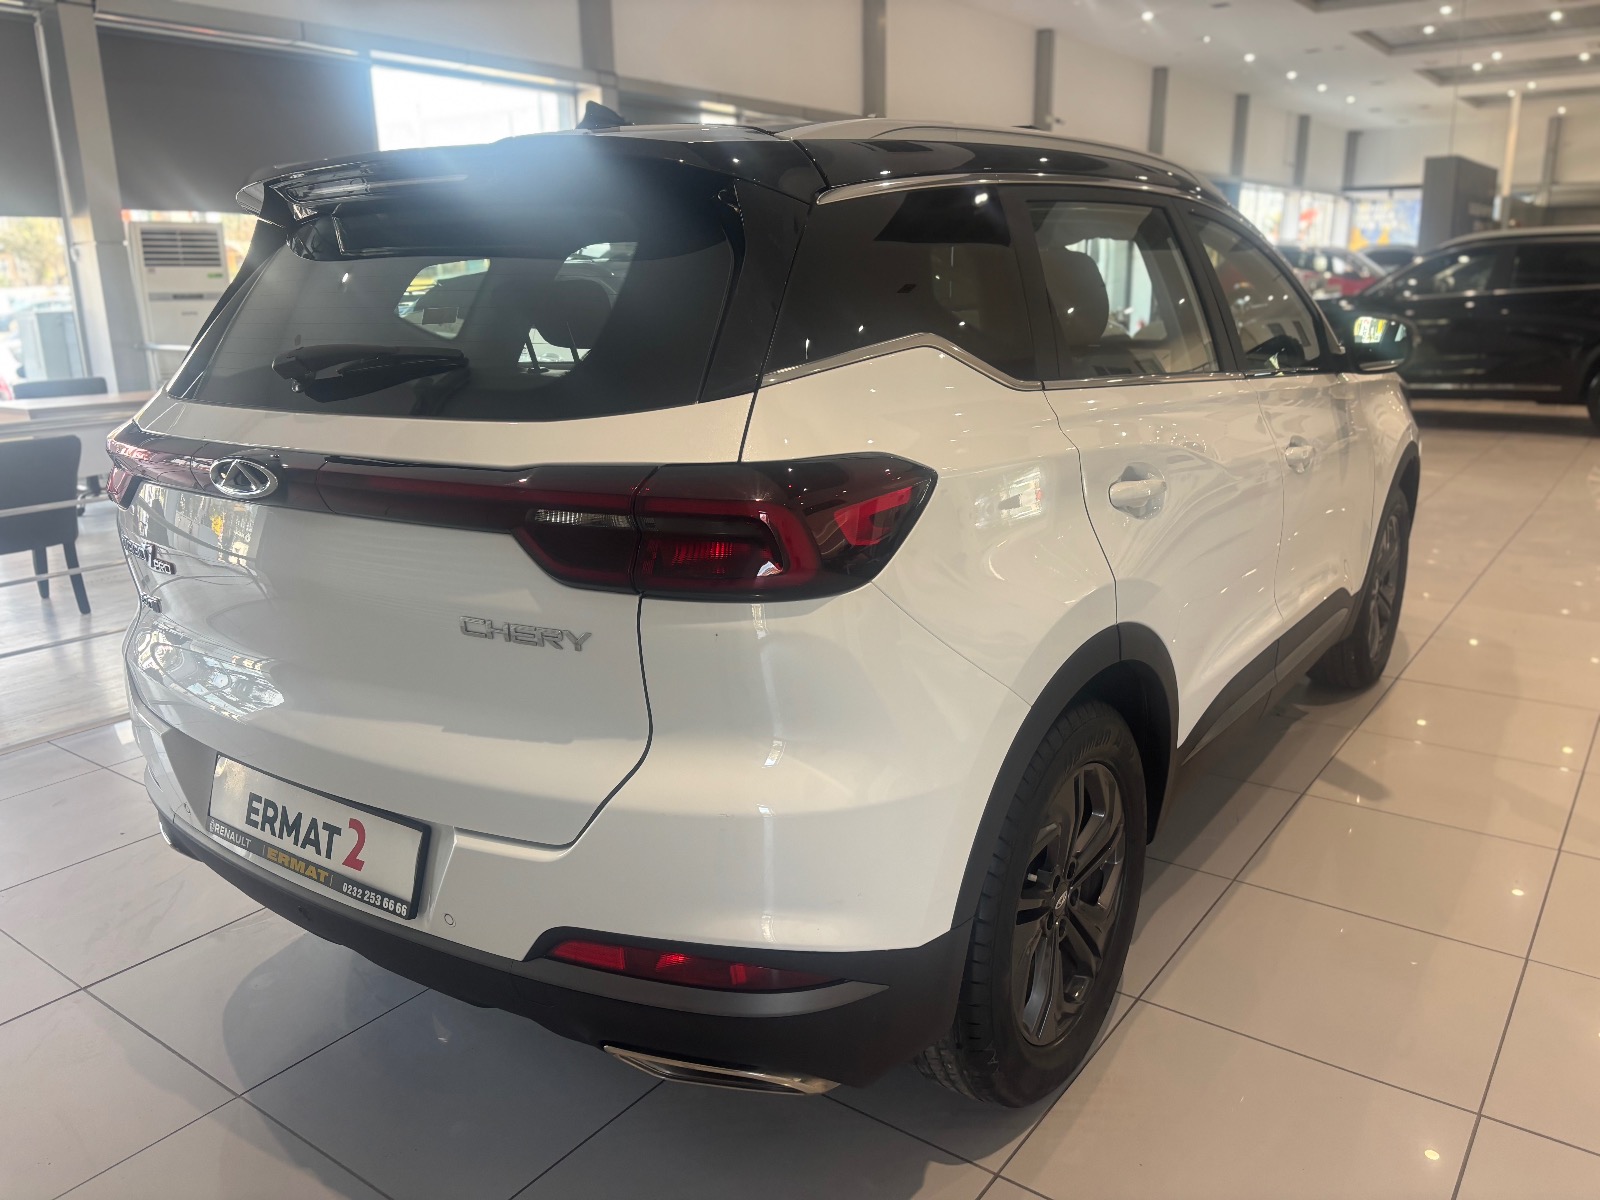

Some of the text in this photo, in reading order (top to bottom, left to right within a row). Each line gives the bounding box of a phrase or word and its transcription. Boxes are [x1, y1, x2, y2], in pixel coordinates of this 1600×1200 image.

[459, 616, 592, 651] CHERY
[214, 821, 252, 849] RENAULT
[266, 848, 330, 884] ERMAT
[342, 882, 363, 900] 0232
[363, 889, 382, 908] 253
[245, 791, 366, 872] ERMAT 2
